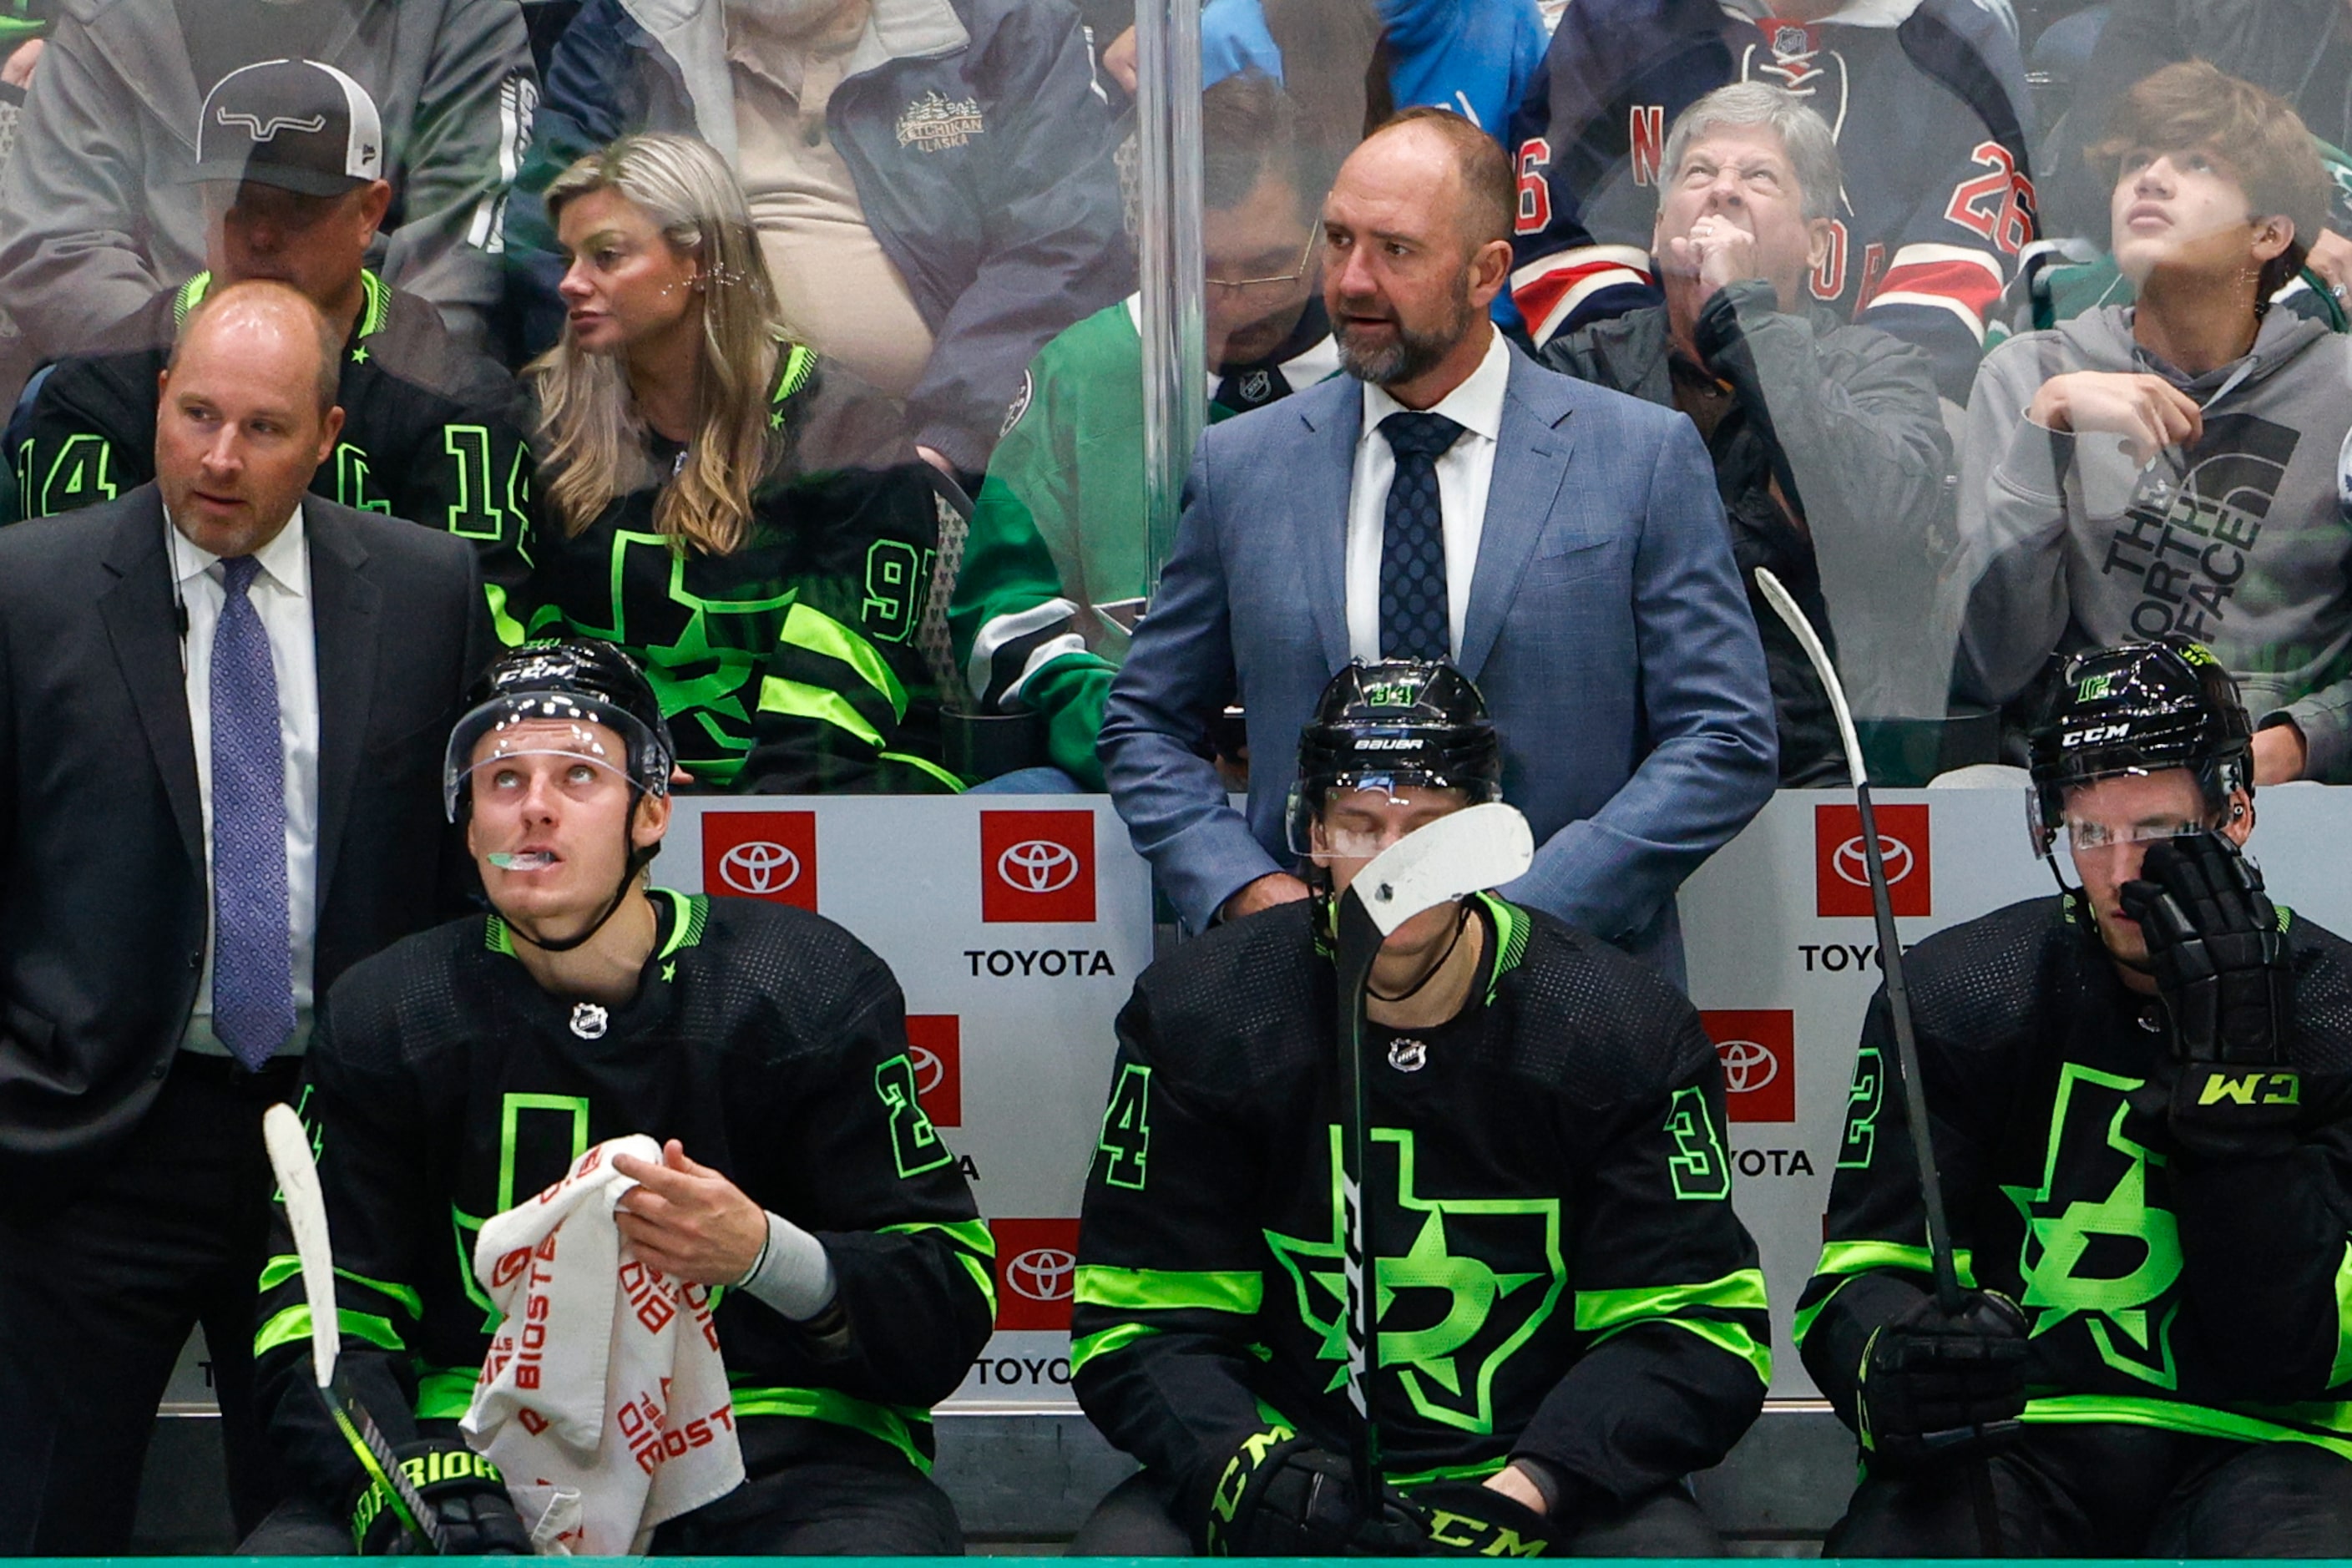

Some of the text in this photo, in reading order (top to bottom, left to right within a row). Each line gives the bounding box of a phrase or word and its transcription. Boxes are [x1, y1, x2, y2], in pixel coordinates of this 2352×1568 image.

[899, 119, 982, 149] KETCHIKAN
[1512, 137, 1552, 236] 6
[1944, 140, 2037, 257] 26
[18, 433, 117, 521] 14
[2102, 494, 2262, 645] THE ORTH FACE
[2061, 723, 2131, 748] CCM
[964, 949, 1116, 977] TOYOTA
[1798, 943, 1914, 972] TOY
[875, 1054, 953, 1179] 2
[1088, 1063, 1151, 1191] 4
[1662, 1085, 1731, 1201] 3
[1731, 1149, 1815, 1177] OTA
[619, 1260, 675, 1335] BIO
[1418, 1505, 1549, 1558] CM
